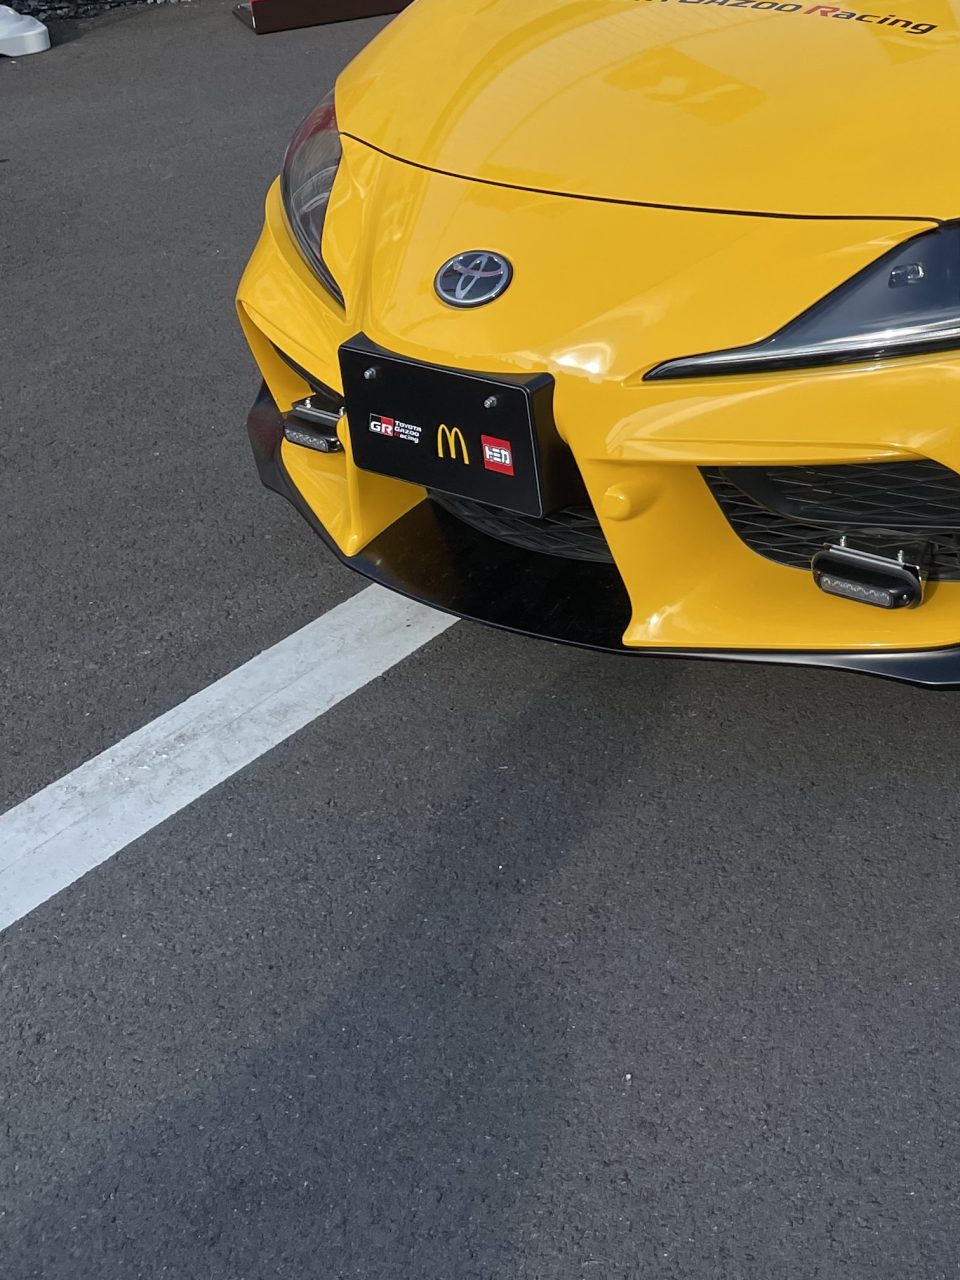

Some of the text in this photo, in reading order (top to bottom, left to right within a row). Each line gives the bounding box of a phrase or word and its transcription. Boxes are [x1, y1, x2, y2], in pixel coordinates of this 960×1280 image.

[804, 5, 939, 34] Racing
[370, 421, 393, 436] GR
[394, 420, 422, 432] TOYOTA
[394, 426, 420, 437] GAZOO
[394, 431, 419, 443] Racing
[485, 445, 512, 466] トミカ
